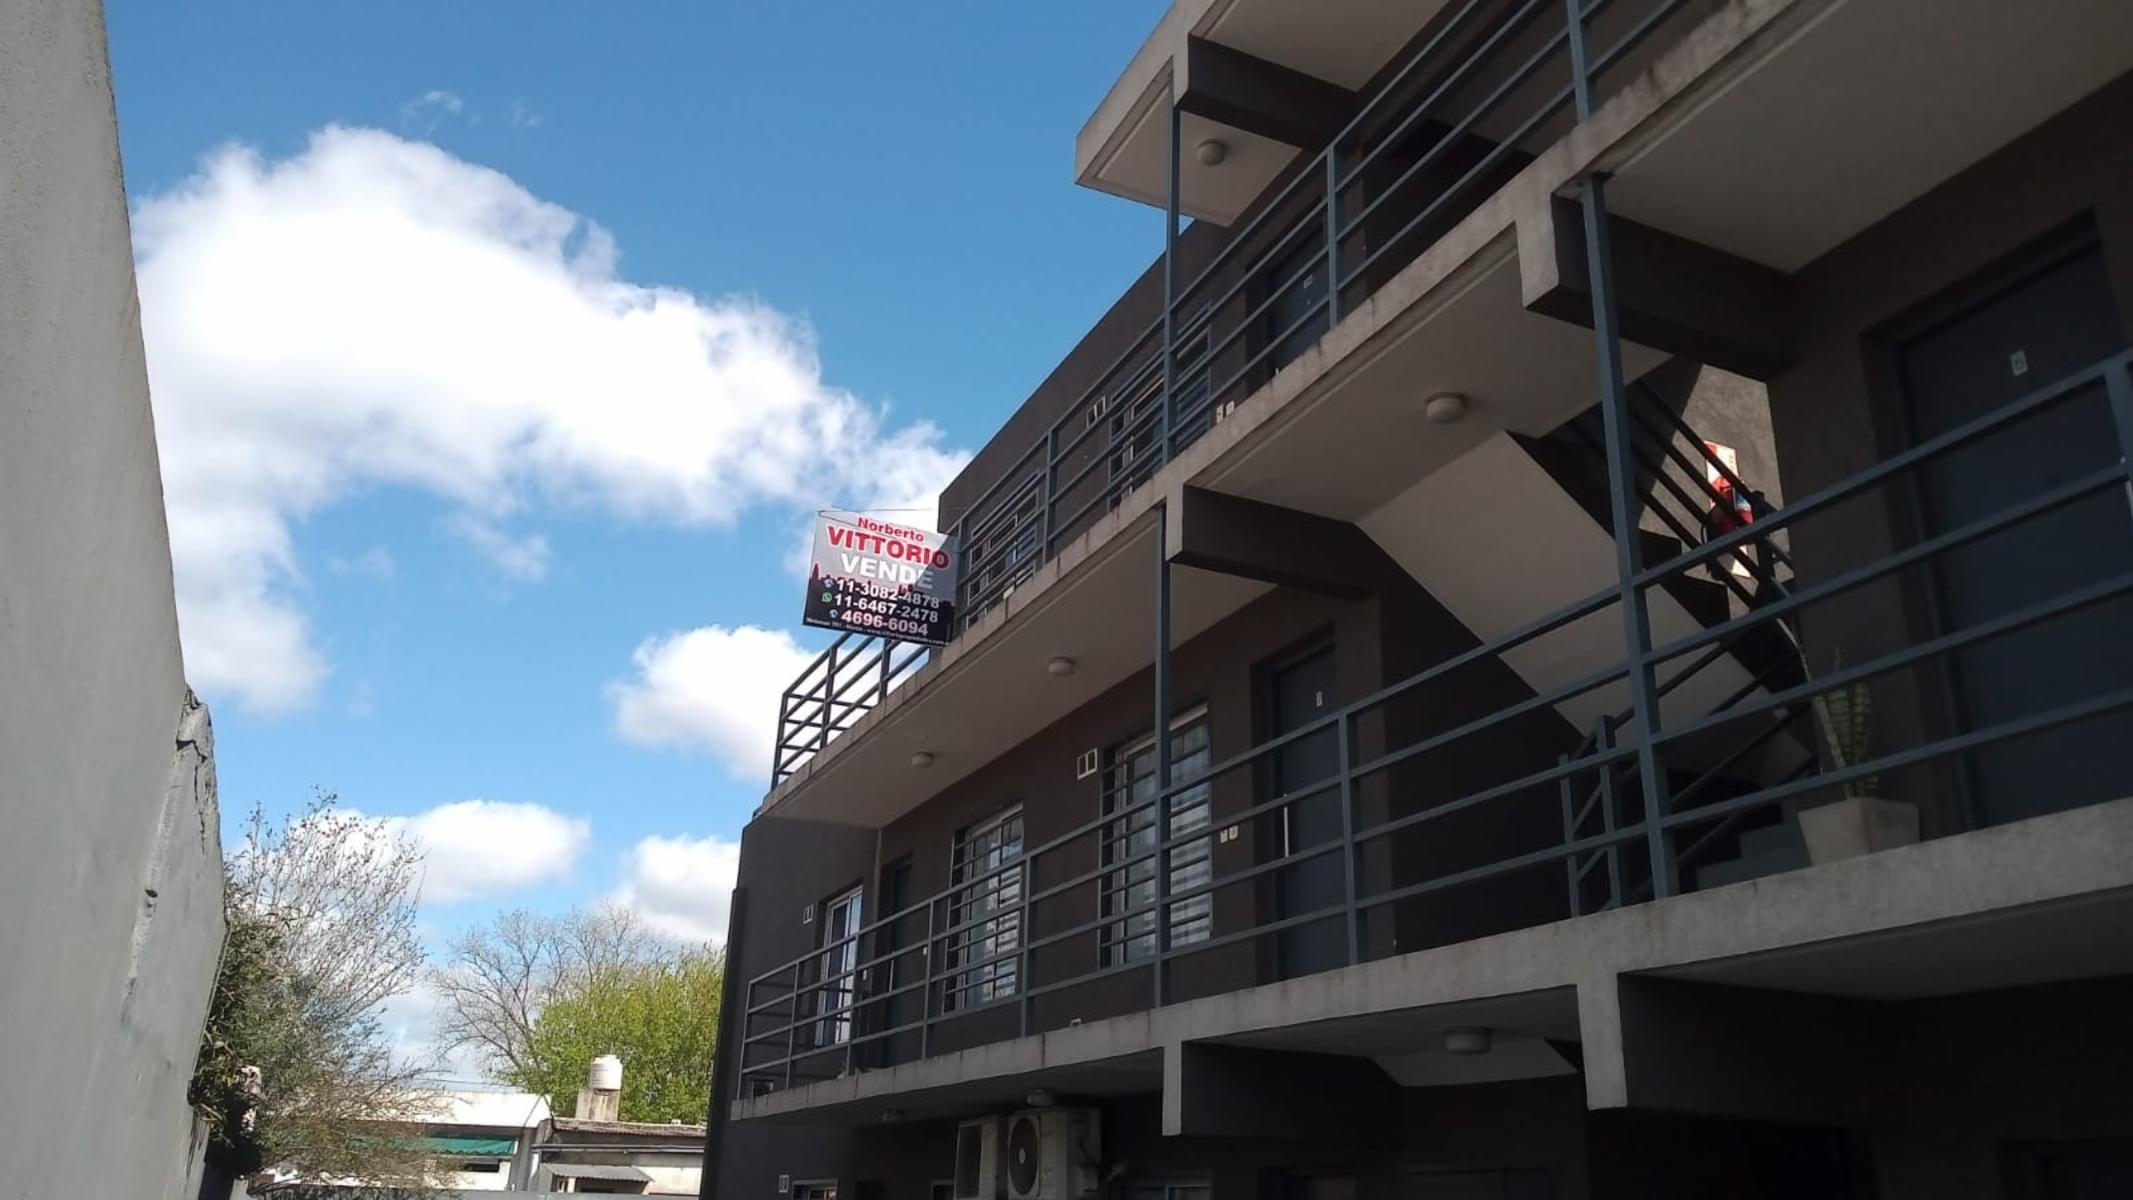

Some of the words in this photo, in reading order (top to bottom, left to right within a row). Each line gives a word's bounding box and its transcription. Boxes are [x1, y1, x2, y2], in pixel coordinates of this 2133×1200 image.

[857, 517, 924, 542] Norberto
[828, 525, 949, 569] VITTORIO
[840, 552, 934, 589] VENDE
[834, 593, 939, 623] 11-6467-2478
[836, 579, 940, 609] 11-3082-4878
[840, 610, 929, 636] 4696-6094
